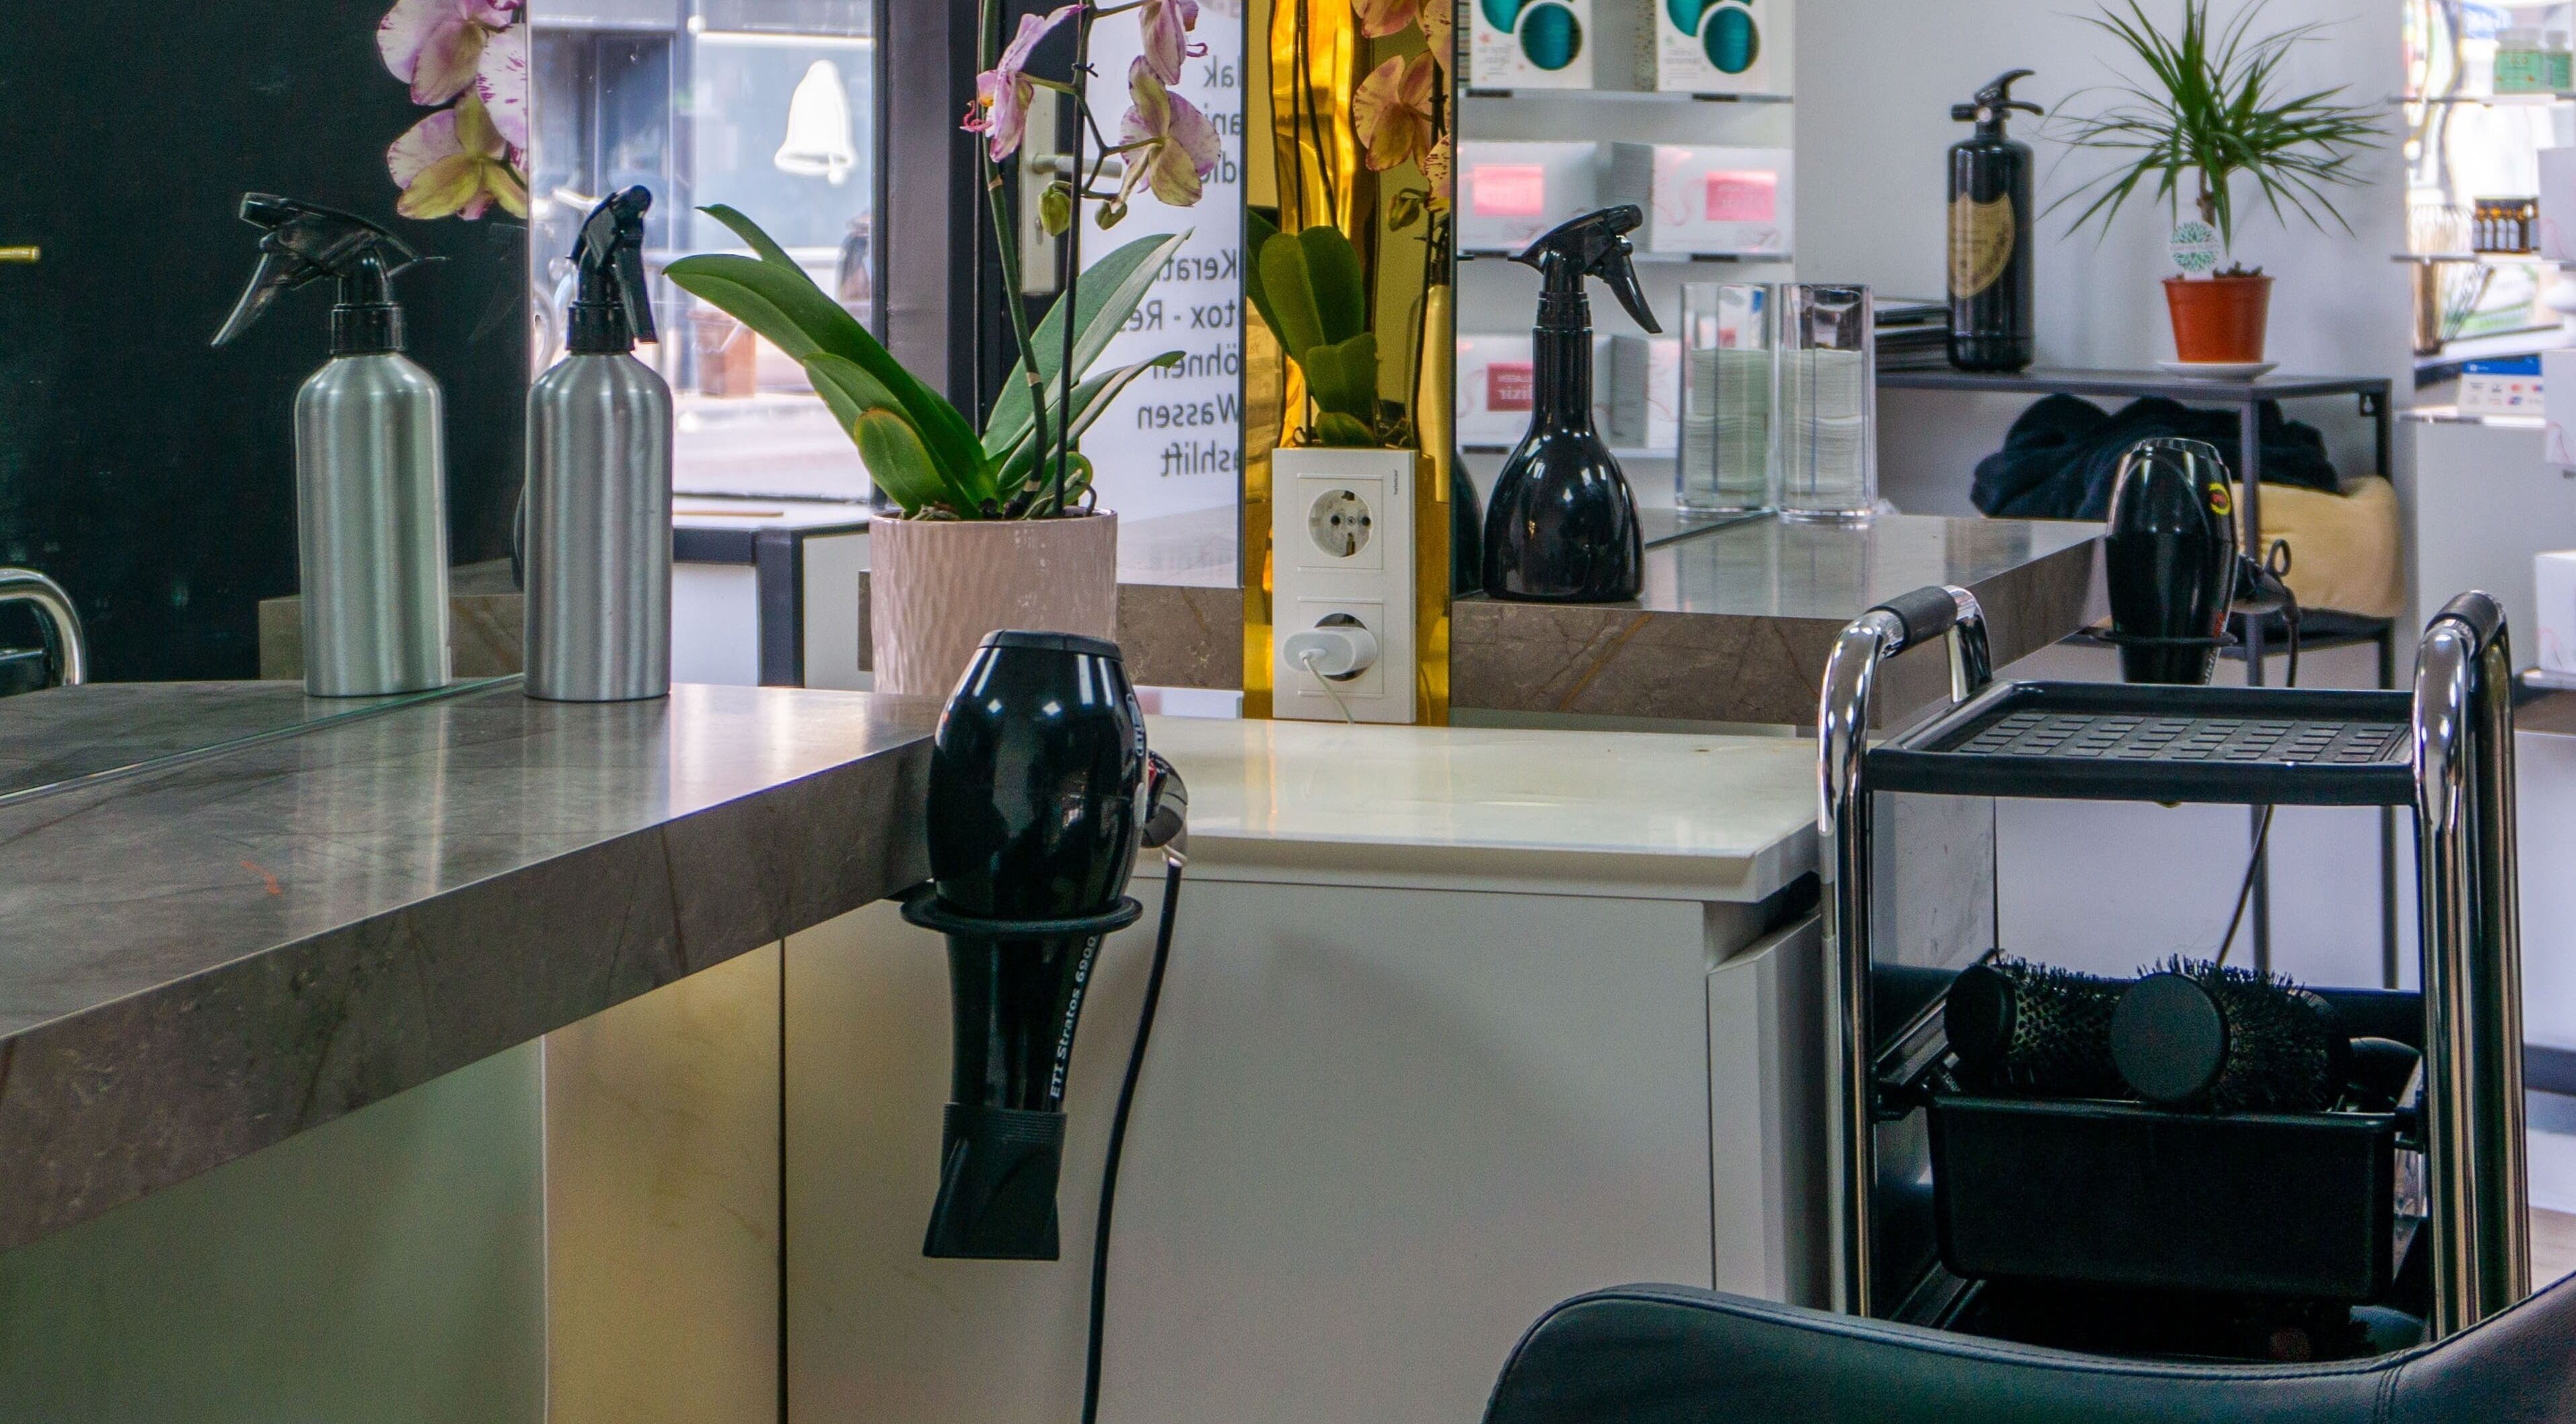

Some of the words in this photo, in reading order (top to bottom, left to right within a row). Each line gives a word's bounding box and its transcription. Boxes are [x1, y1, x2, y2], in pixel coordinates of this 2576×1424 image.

[1075, 935, 1097, 983] 6900
[1056, 987, 1080, 1059] Stratos
[1050, 1063, 1065, 1098] ETI
